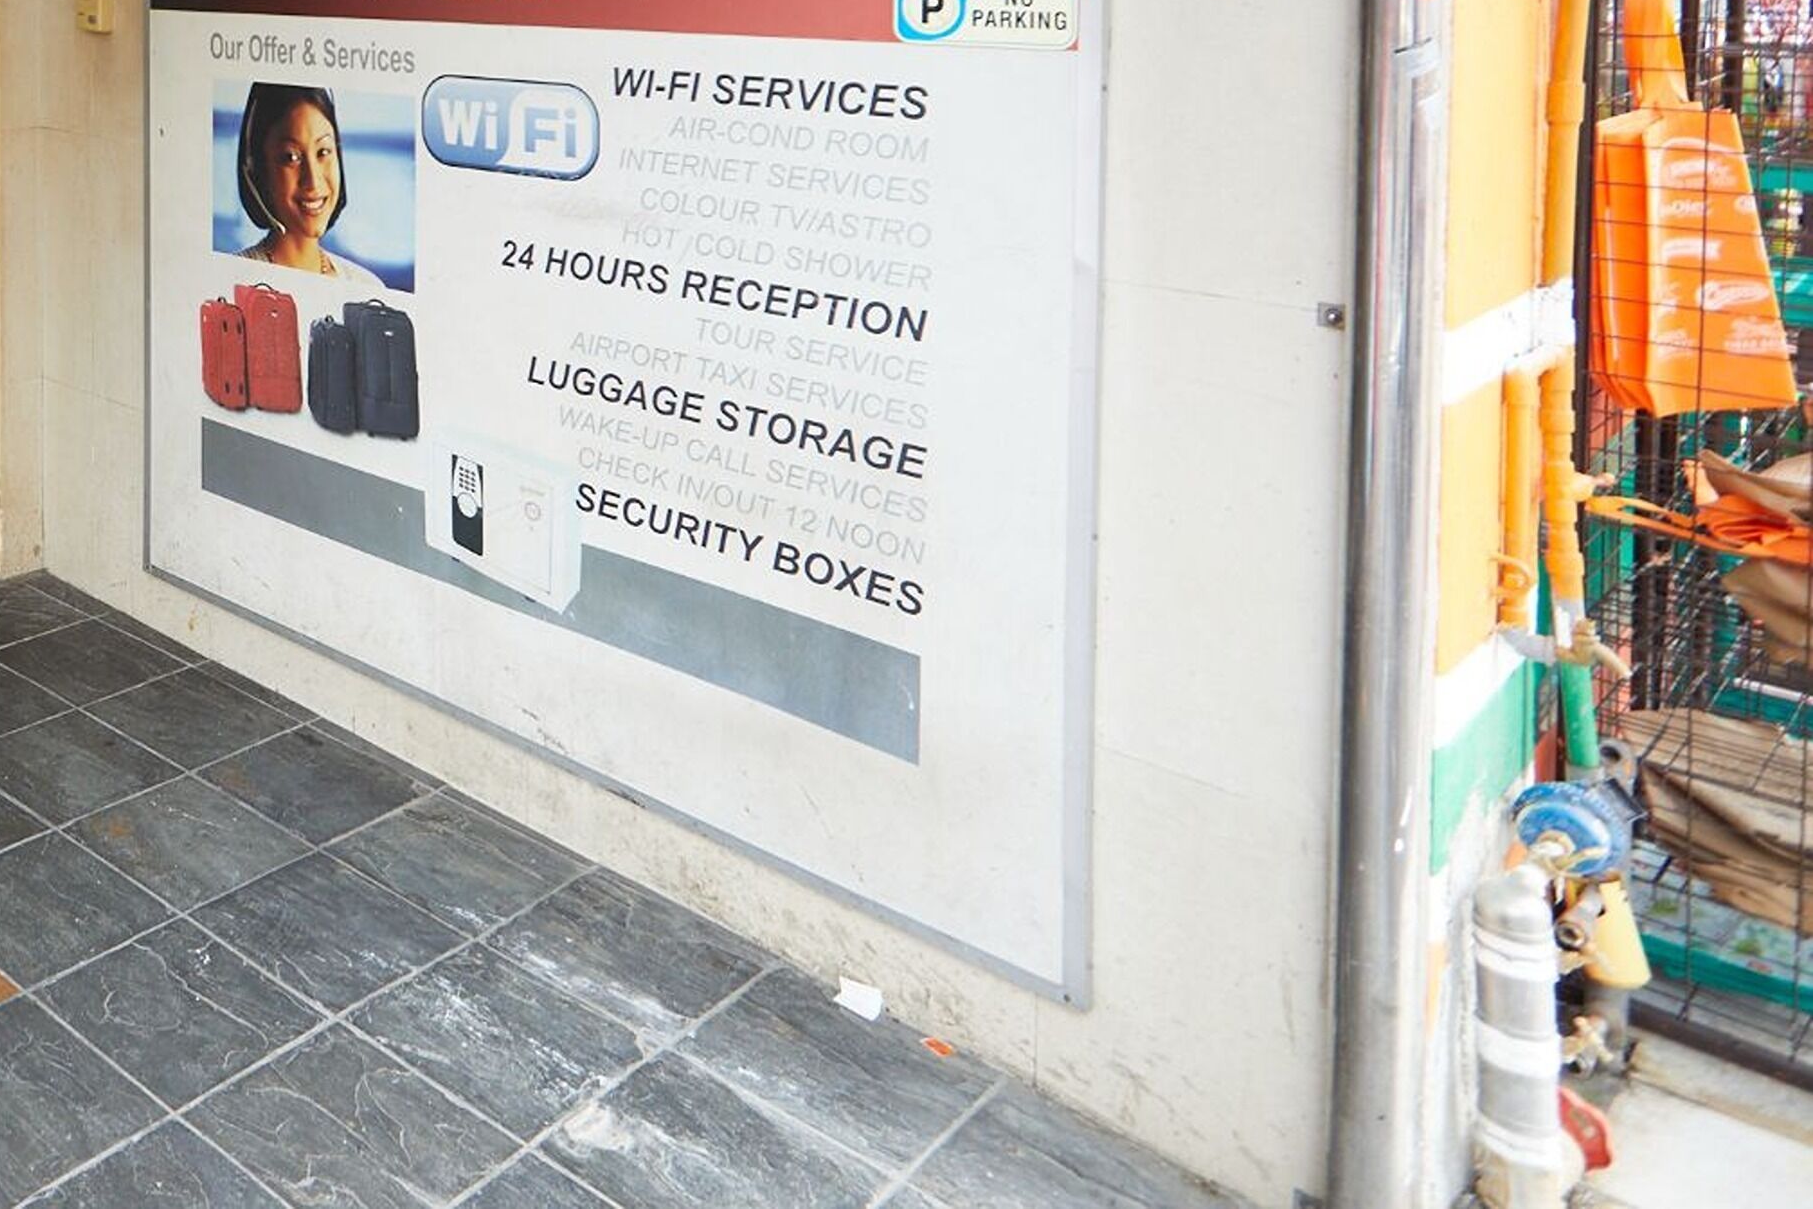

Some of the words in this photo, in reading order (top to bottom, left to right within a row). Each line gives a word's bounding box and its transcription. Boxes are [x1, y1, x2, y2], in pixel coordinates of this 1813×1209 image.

[210, 32, 243, 61] Our
[249, 35, 296, 65] Offer
[302, 40, 316, 66] &
[324, 39, 415, 73] Services
[971, 9, 1067, 31] PARKING
[612, 67, 700, 102] WI-FI
[712, 74, 929, 120] SERVICES
[668, 115, 814, 152] AIR-COND
[825, 130, 930, 164] ROOM
[619, 148, 765, 185] INTERNET
[767, 163, 930, 206] SERVICES
[640, 187, 760, 226] COLOUR
[772, 204, 932, 249] TV/ASTRO
[502, 240, 534, 271] 24
[545, 247, 670, 294] HOURS
[682, 271, 929, 342] RECEPTION
[622, 224, 680, 251] HOT
[791, 246, 932, 291] SHOWER
[570, 332, 688, 375] AIRPORT
[696, 357, 757, 390] TAXI
[767, 373, 929, 430] SERVICES
[697, 317, 776, 356] TOUR
[786, 337, 929, 387] SERVICE
[527, 356, 705, 423] LUGGAGE
[716, 400, 928, 479] STORAGE
[559, 404, 680, 450] WAKE-UP
[687, 439, 757, 478] CALL
[767, 466, 929, 522] SERVICES
[578, 447, 668, 489] CHECK
[679, 474, 776, 521] IN/OUT
[786, 505, 816, 533] 12
[825, 517, 926, 565] NOON
[575, 482, 764, 562] SECURITY
[773, 542, 925, 616] BOXES
